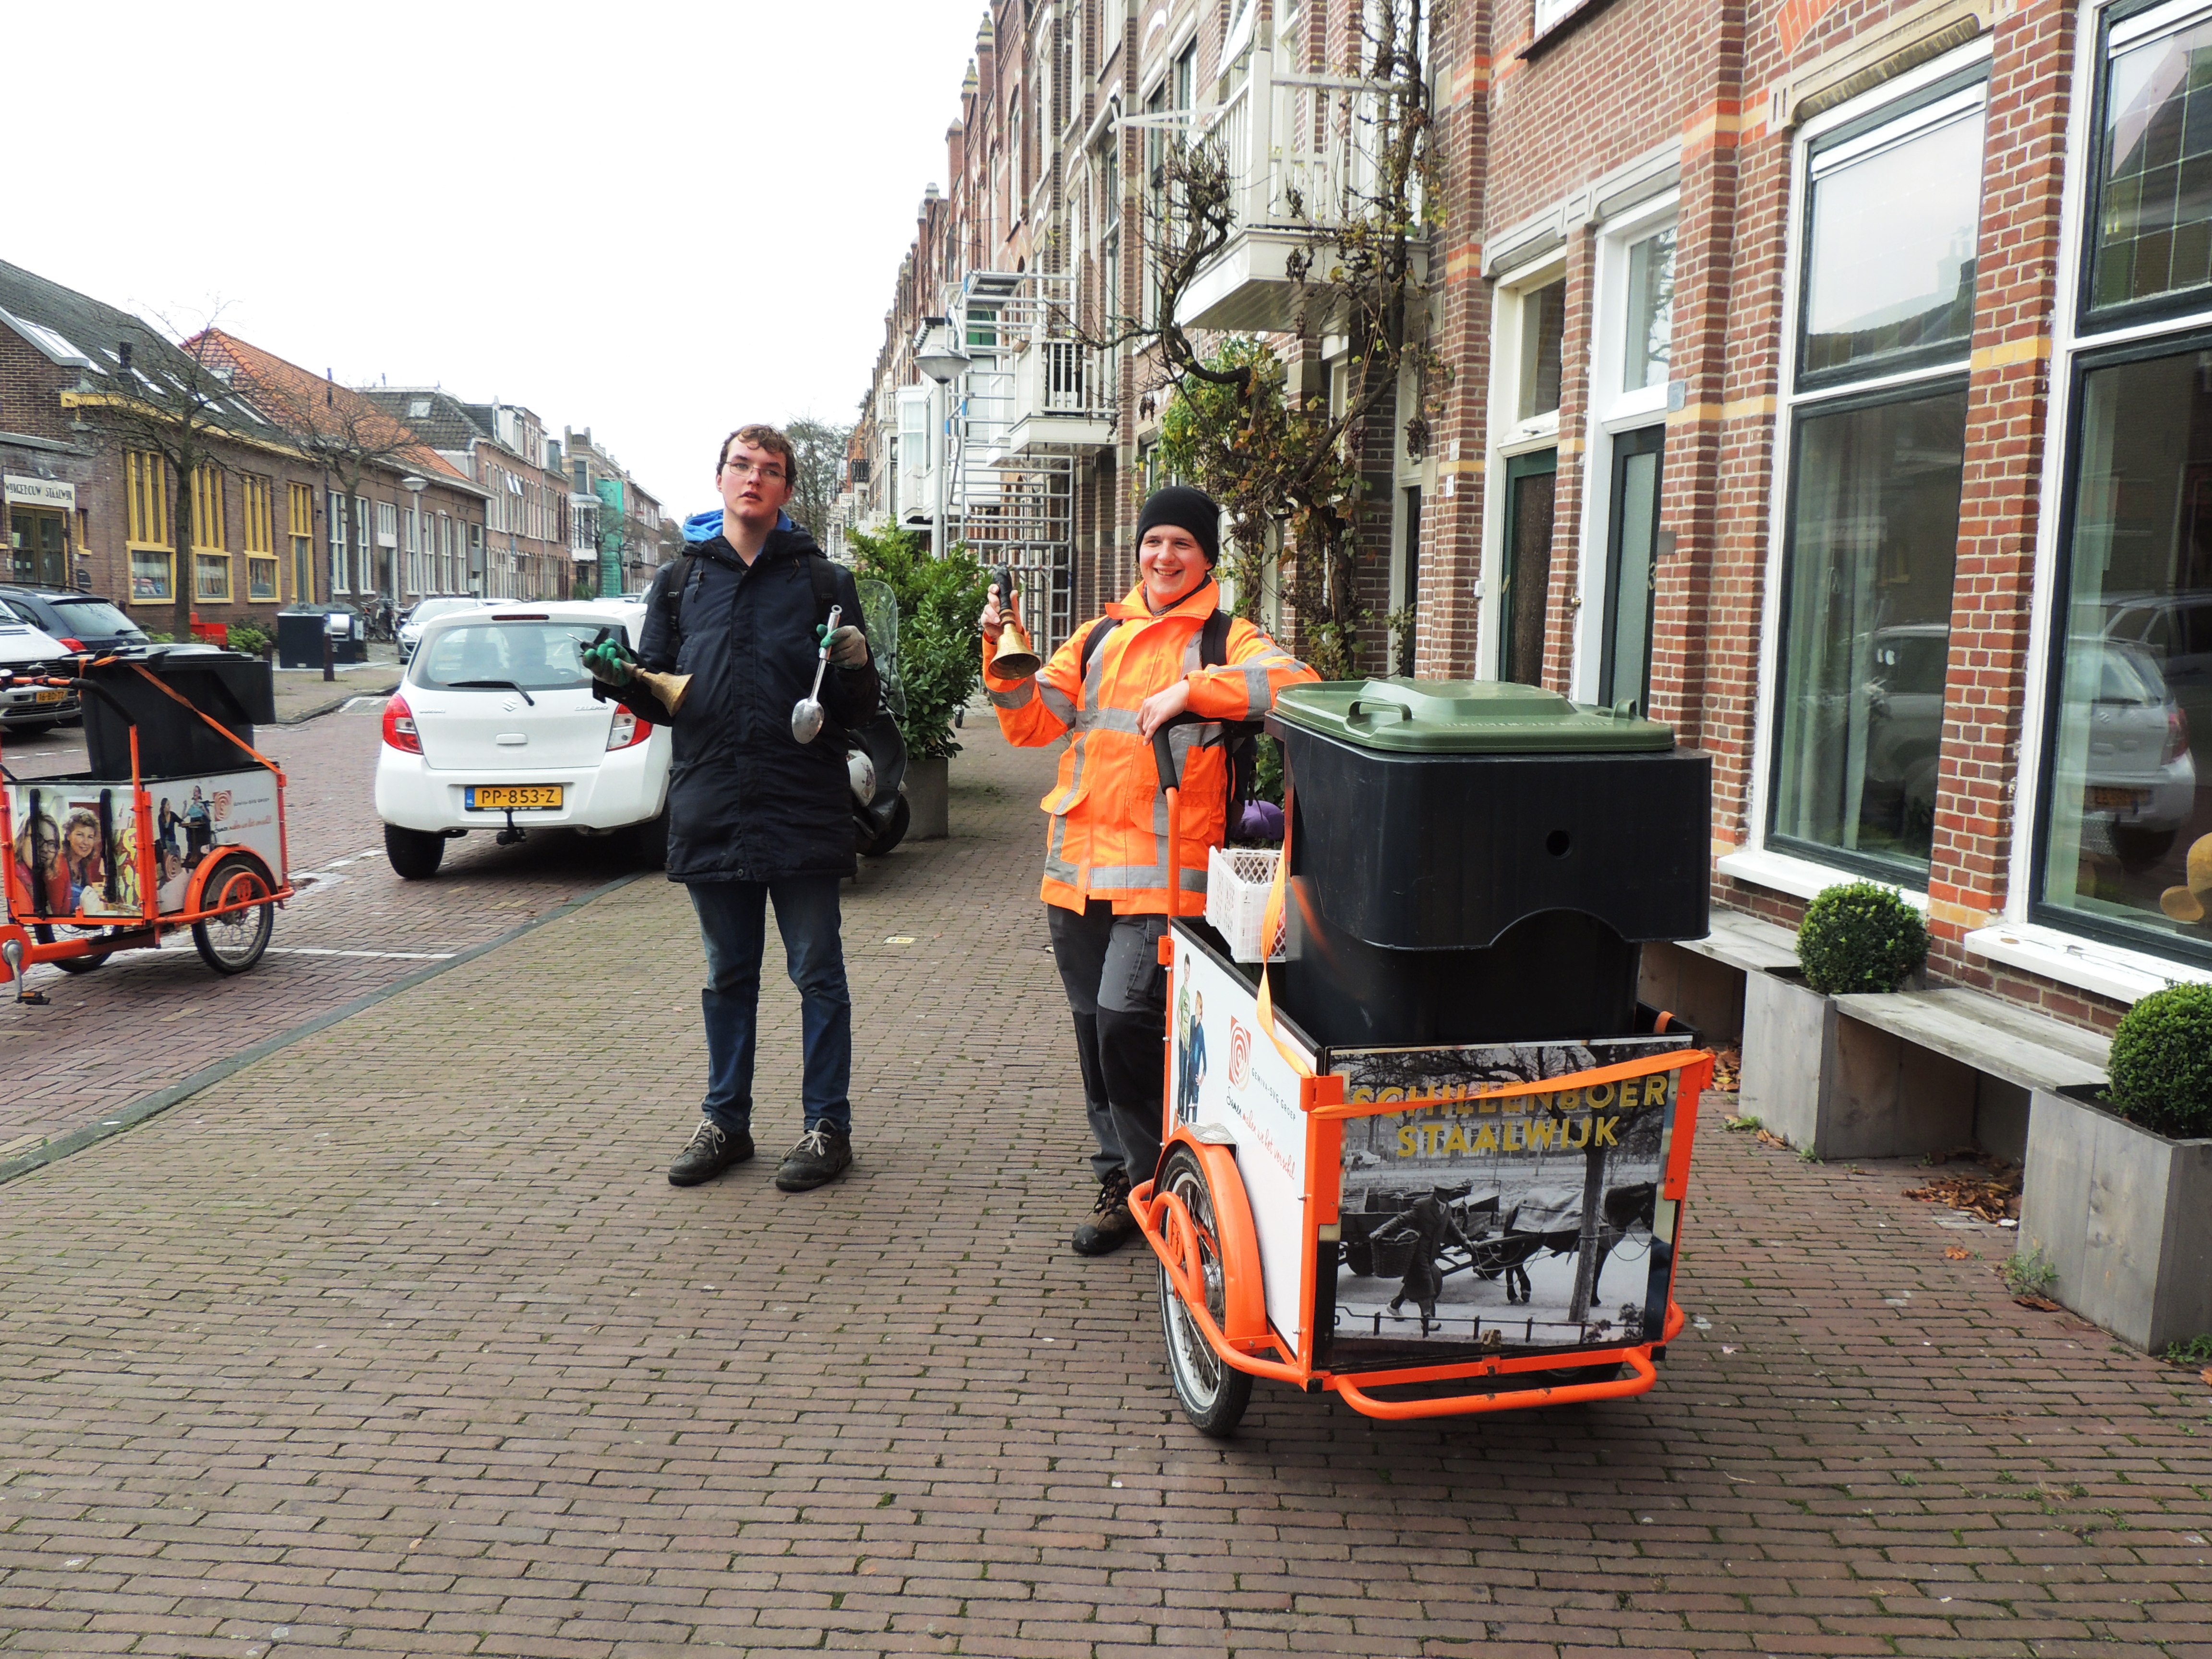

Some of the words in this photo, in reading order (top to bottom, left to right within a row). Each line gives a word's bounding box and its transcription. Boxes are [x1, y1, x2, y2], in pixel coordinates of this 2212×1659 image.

[481, 789, 554, 804] PP-853-Z
[1251, 1067, 1279, 1104] GEMIVA-SVG
[1281, 1099, 1296, 1122] GROEP
[1352, 1075, 1668, 1119] SCHILLENBOER
[1226, 1086, 1242, 1118] Samen
[1242, 1110, 1256, 1135] maken
[1257, 1130, 1264, 1144] we
[1265, 1129, 1274, 1154] het
[1274, 1150, 1295, 1180] verschil
[1396, 1116, 1622, 1157] STAALWIJK
